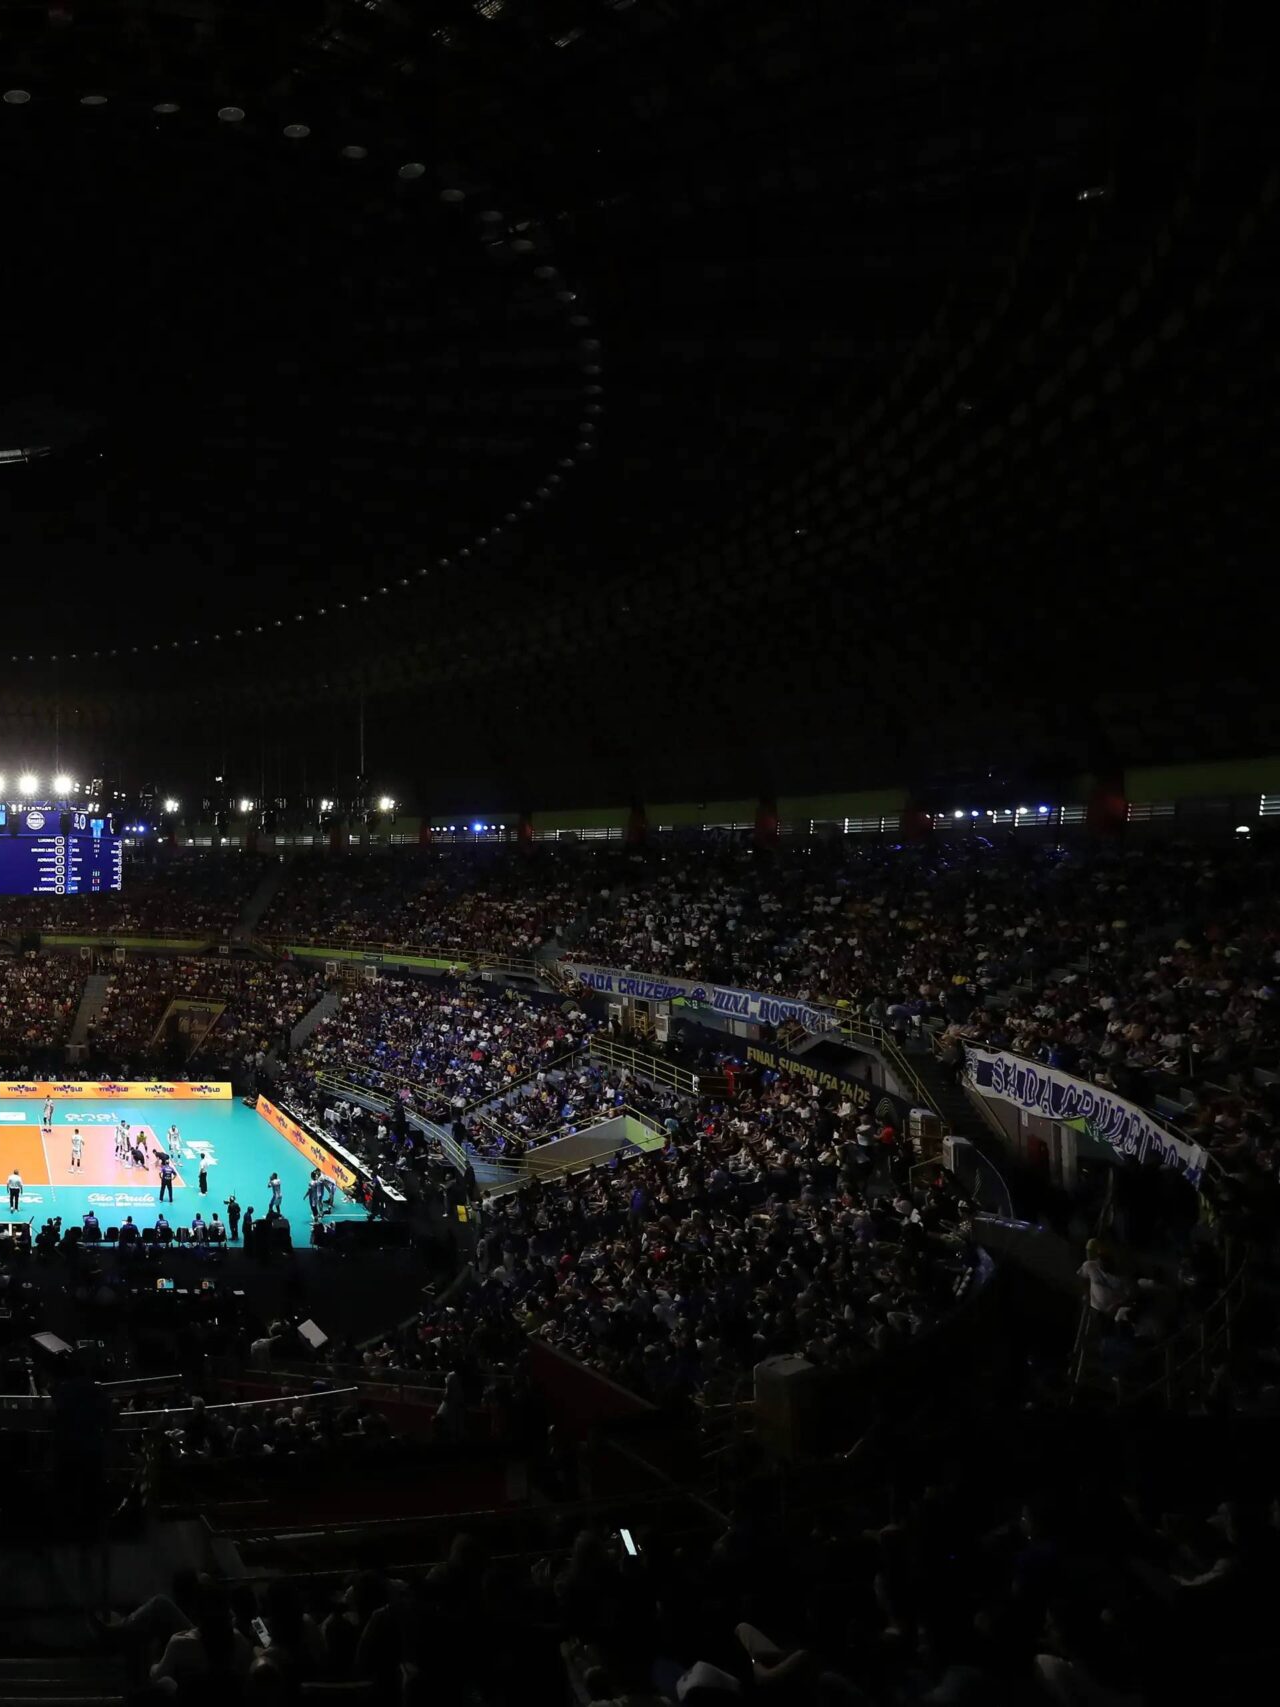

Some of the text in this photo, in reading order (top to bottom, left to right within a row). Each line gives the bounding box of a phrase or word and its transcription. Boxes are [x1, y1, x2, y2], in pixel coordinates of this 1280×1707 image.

[579, 971, 685, 1000] SADA CRUZEIRO
[746, 1045, 872, 1106] FINAL SUPERLIGA 24/25
[991, 1057, 1180, 1168] SADA CRUZEIRO
[87, 1192, 154, 1203] São Paulo
